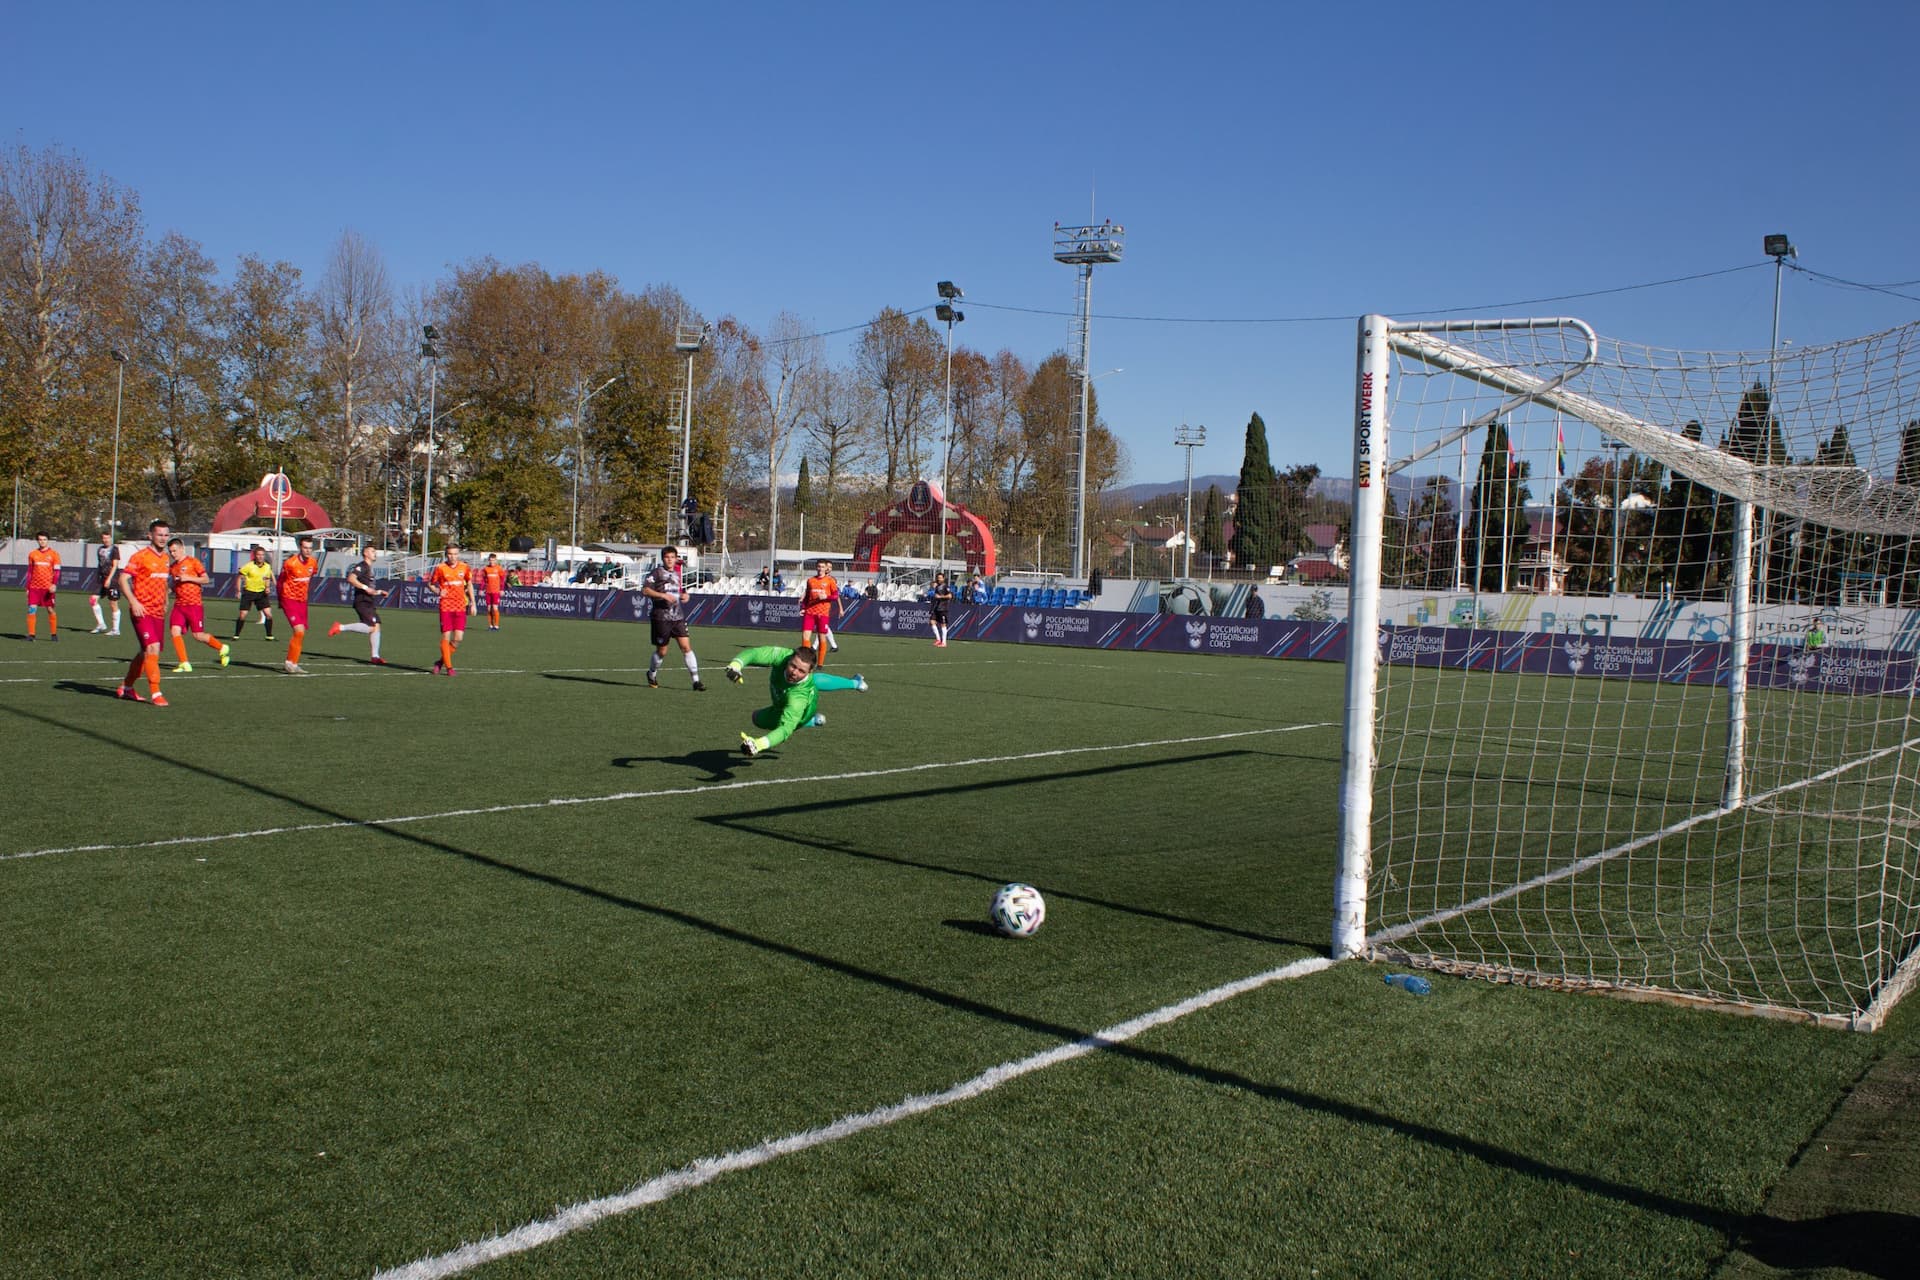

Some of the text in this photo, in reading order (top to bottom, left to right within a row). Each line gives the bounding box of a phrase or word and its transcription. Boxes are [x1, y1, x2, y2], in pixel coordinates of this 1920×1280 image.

[1360, 371, 1373, 455] SPORTWERK
[532, 592, 542, 600] ПО
[543, 593, 576, 601] ФУТБОЛУ
[898, 609, 931, 617] РОССИЙСК
[1045, 616, 1089, 625] РОССИЙСКИЙ
[1045, 623, 1089, 633] ФУТБОЛЬНЫЙ
[1210, 625, 1258, 634] РОССИЙСКИЙ
[1044, 630, 1065, 638] СОЮЗ
[1210, 633, 1258, 642] ФУТБОЛЬНЫЙ
[1209, 640, 1231, 648] СОЮЗ
[1392, 650, 1414, 658] СОЮЗ
[1594, 645, 1653, 656] РОССИЙСКИЙ
[1594, 654, 1653, 664] ФУТБОЛЬНЫЙ
[1593, 662, 1620, 671] СОЮЗ
